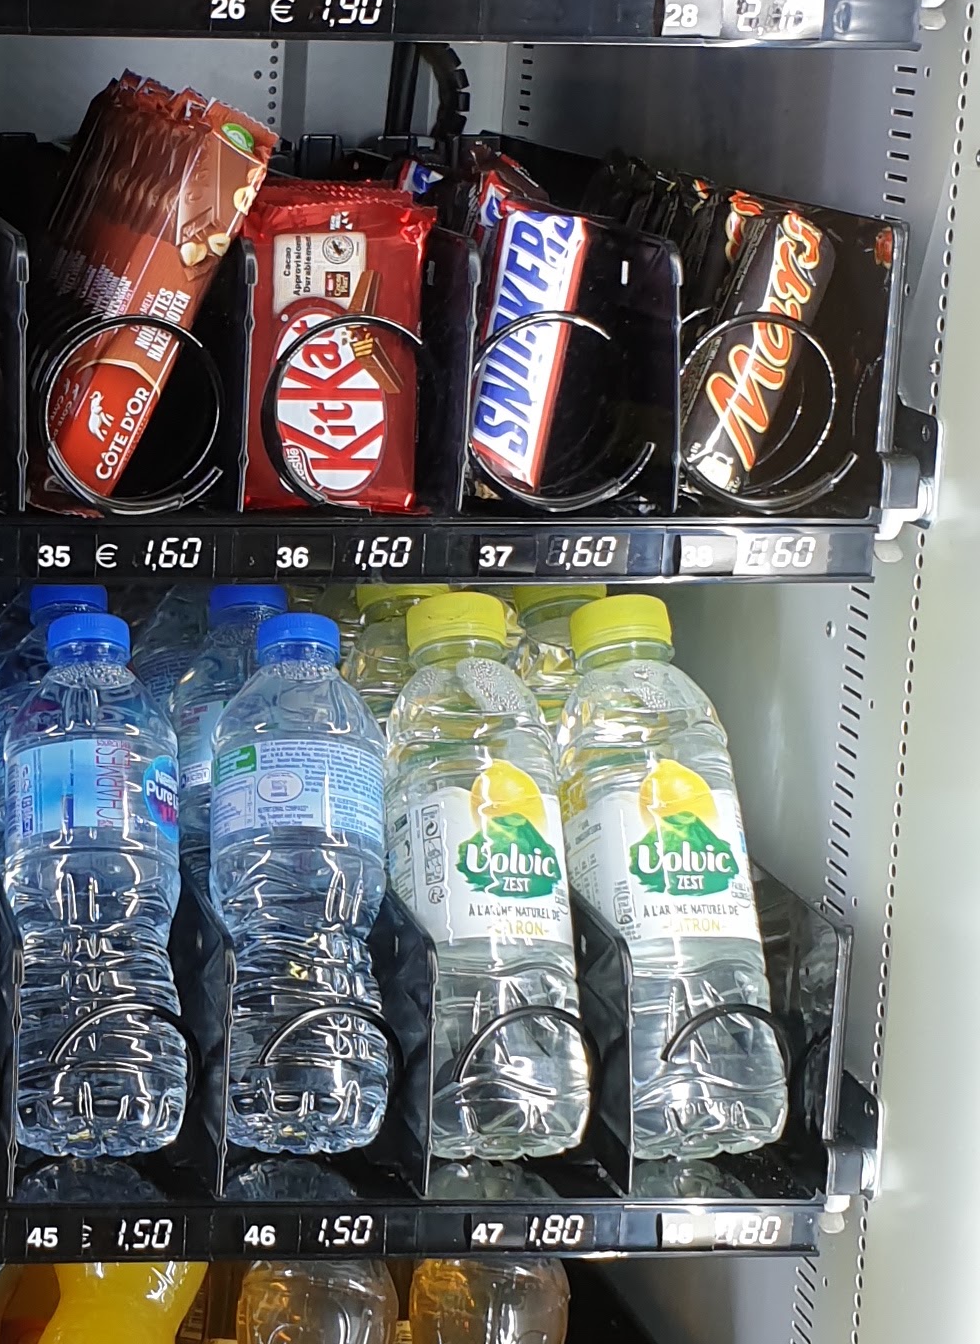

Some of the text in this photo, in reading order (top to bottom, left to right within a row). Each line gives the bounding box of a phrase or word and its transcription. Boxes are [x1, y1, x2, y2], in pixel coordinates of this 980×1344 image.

[663, 3, 699, 28] 28
[283, 247, 291, 277] Cacao
[706, 210, 823, 473] Mars
[278, 320, 384, 470] KitKat
[93, 385, 152, 482] CÔTE D'OR
[38, 545, 71, 567] 35
[95, 538, 202, 569] € 1,60
[277, 547, 310, 568] 36
[354, 537, 412, 571] 1,60
[478, 545, 512, 568] 37
[557, 536, 617, 569] 1,60
[146, 779, 174, 807] Pure
[466, 842, 556, 879] Volvic
[637, 842, 732, 874] Volvic
[502, 875, 531, 892] ZEST
[676, 874, 704, 891] ZEST
[515, 906, 549, 918] NATUREL
[690, 904, 727, 916] NATUREL
[26, 1226, 59, 1249] 45
[118, 1219, 174, 1253] 1,50
[243, 1224, 276, 1247] 46
[317, 1215, 373, 1248] 1,50
[471, 1221, 504, 1244] 47
[527, 1214, 584, 1245] 1,80
